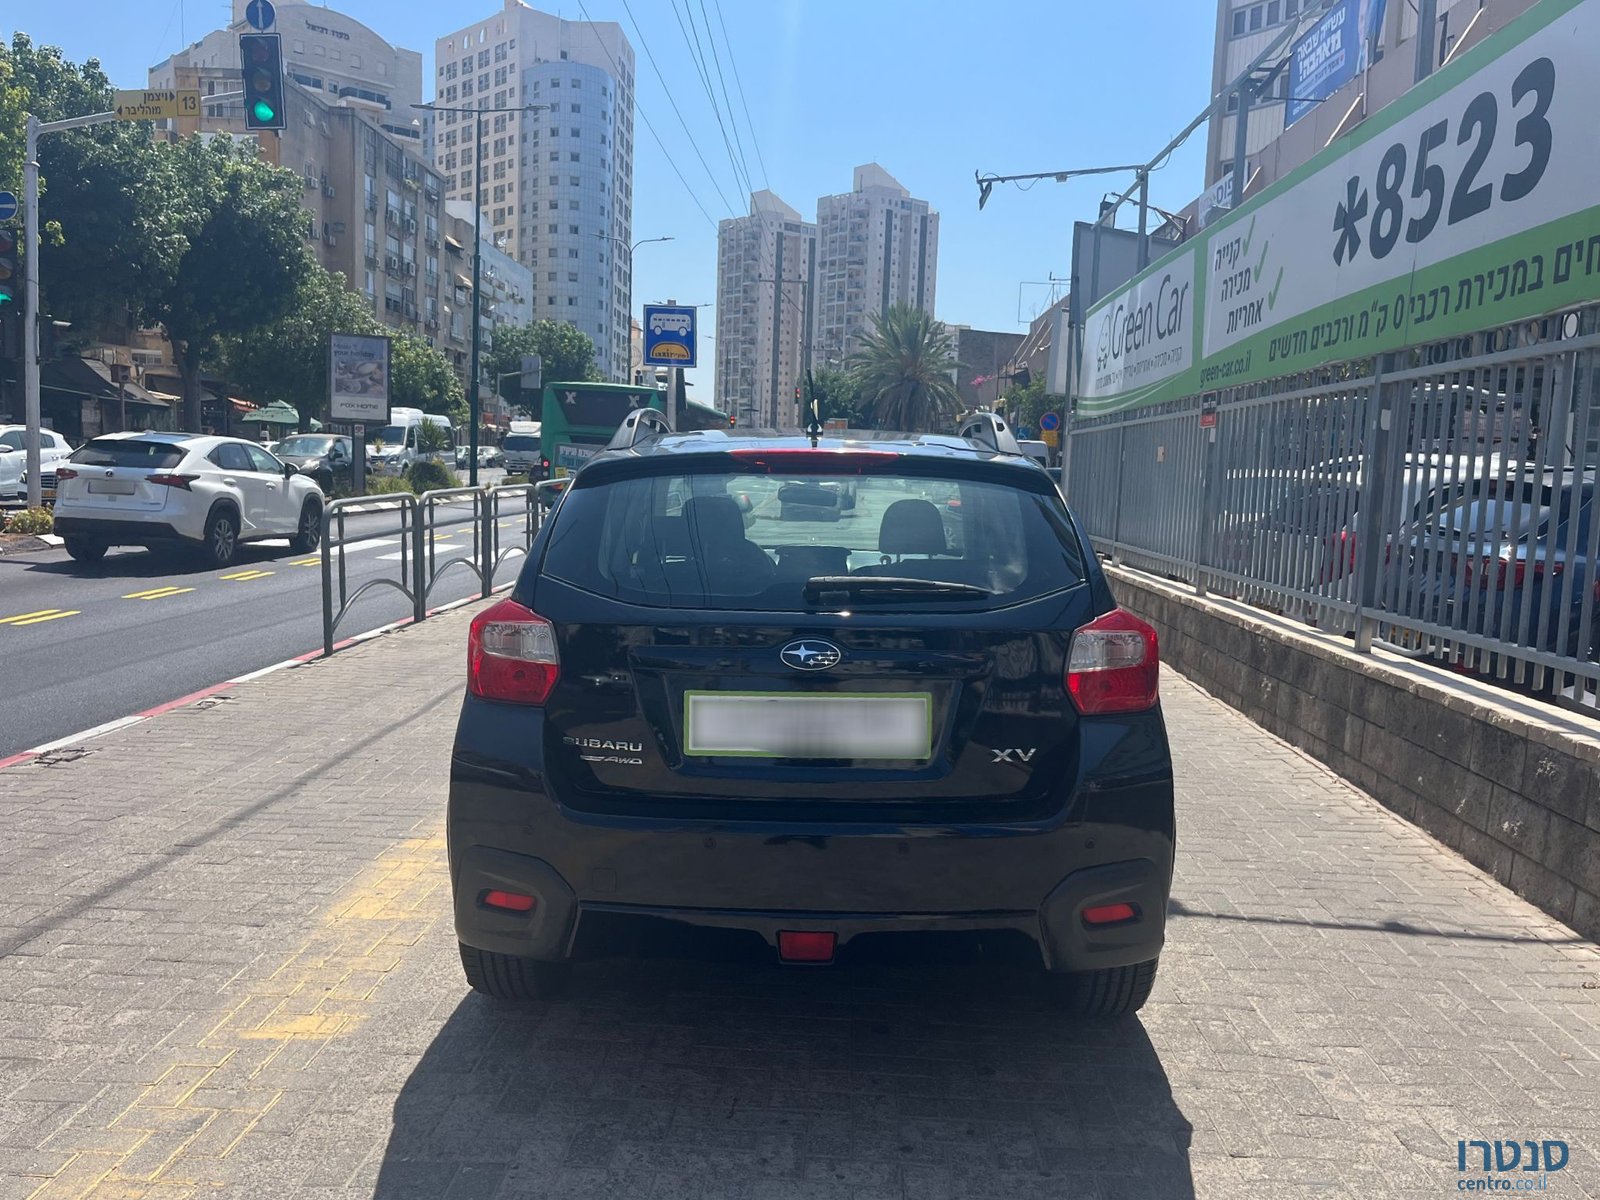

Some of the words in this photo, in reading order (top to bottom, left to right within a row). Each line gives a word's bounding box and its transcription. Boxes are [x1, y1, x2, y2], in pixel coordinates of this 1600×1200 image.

[125, 103, 161, 115] מוהליבר
[143, 92, 168, 104] ויצמן
[182, 95, 196, 111] 13
[1215, 237, 1241, 271] קנייה
[1221, 267, 1251, 302] מכירה
[1454, 254, 1544, 312] במכירת
[1112, 301, 1153, 360] Green
[1156, 274, 1189, 340] Car
[1226, 297, 1264, 335] אחריות
[1409, 285, 1450, 325] רכבי
[1268, 329, 1307, 362] חדשים
[1310, 314, 1354, 350] ורכבים
[1200, 349, 1251, 388] green-car.co.il
[562, 736, 643, 752] SUBARU
[991, 748, 1037, 763] XV
